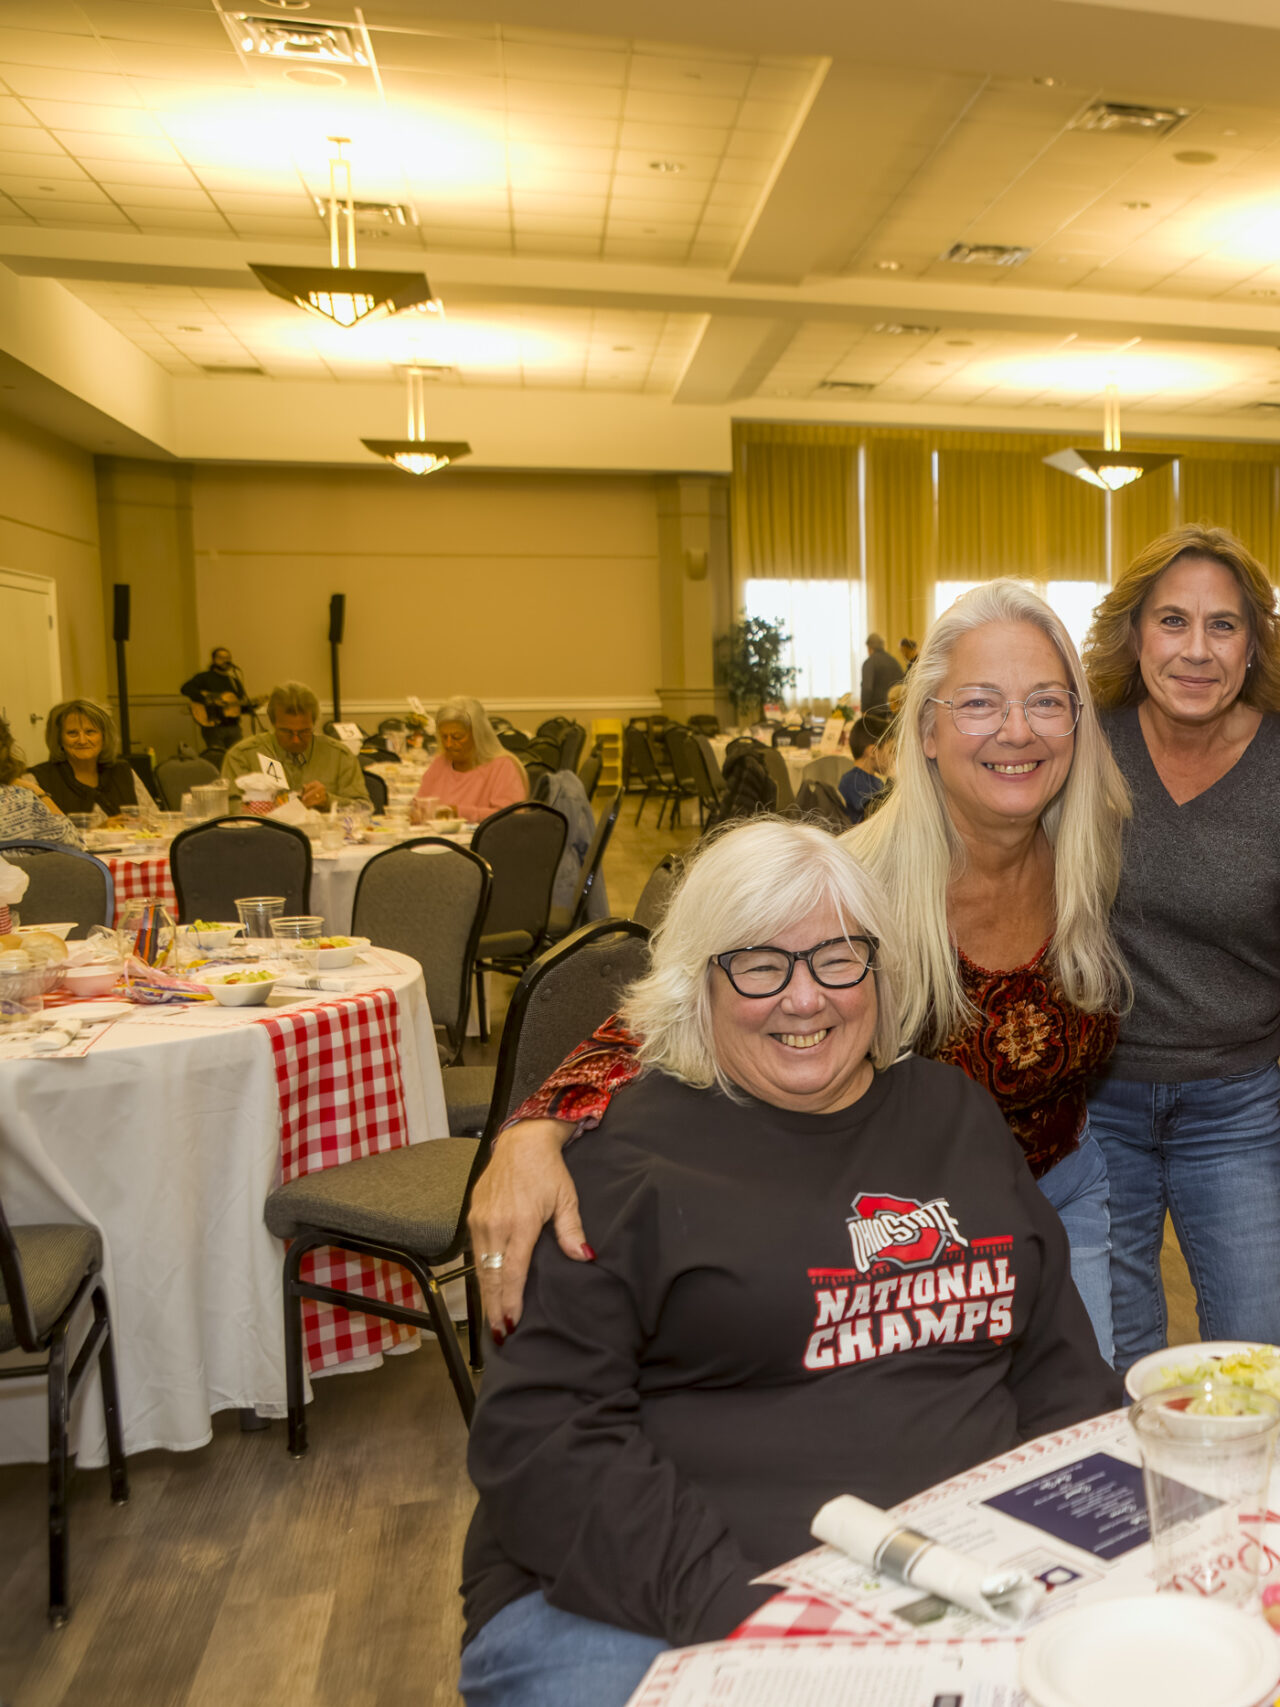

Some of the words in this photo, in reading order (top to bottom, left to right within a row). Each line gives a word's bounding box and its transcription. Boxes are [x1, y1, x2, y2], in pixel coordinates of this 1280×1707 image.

[266, 761, 282, 783] 4
[813, 1256, 1016, 1329] NATIONAL
[803, 1294, 1015, 1370] CHAMPS
